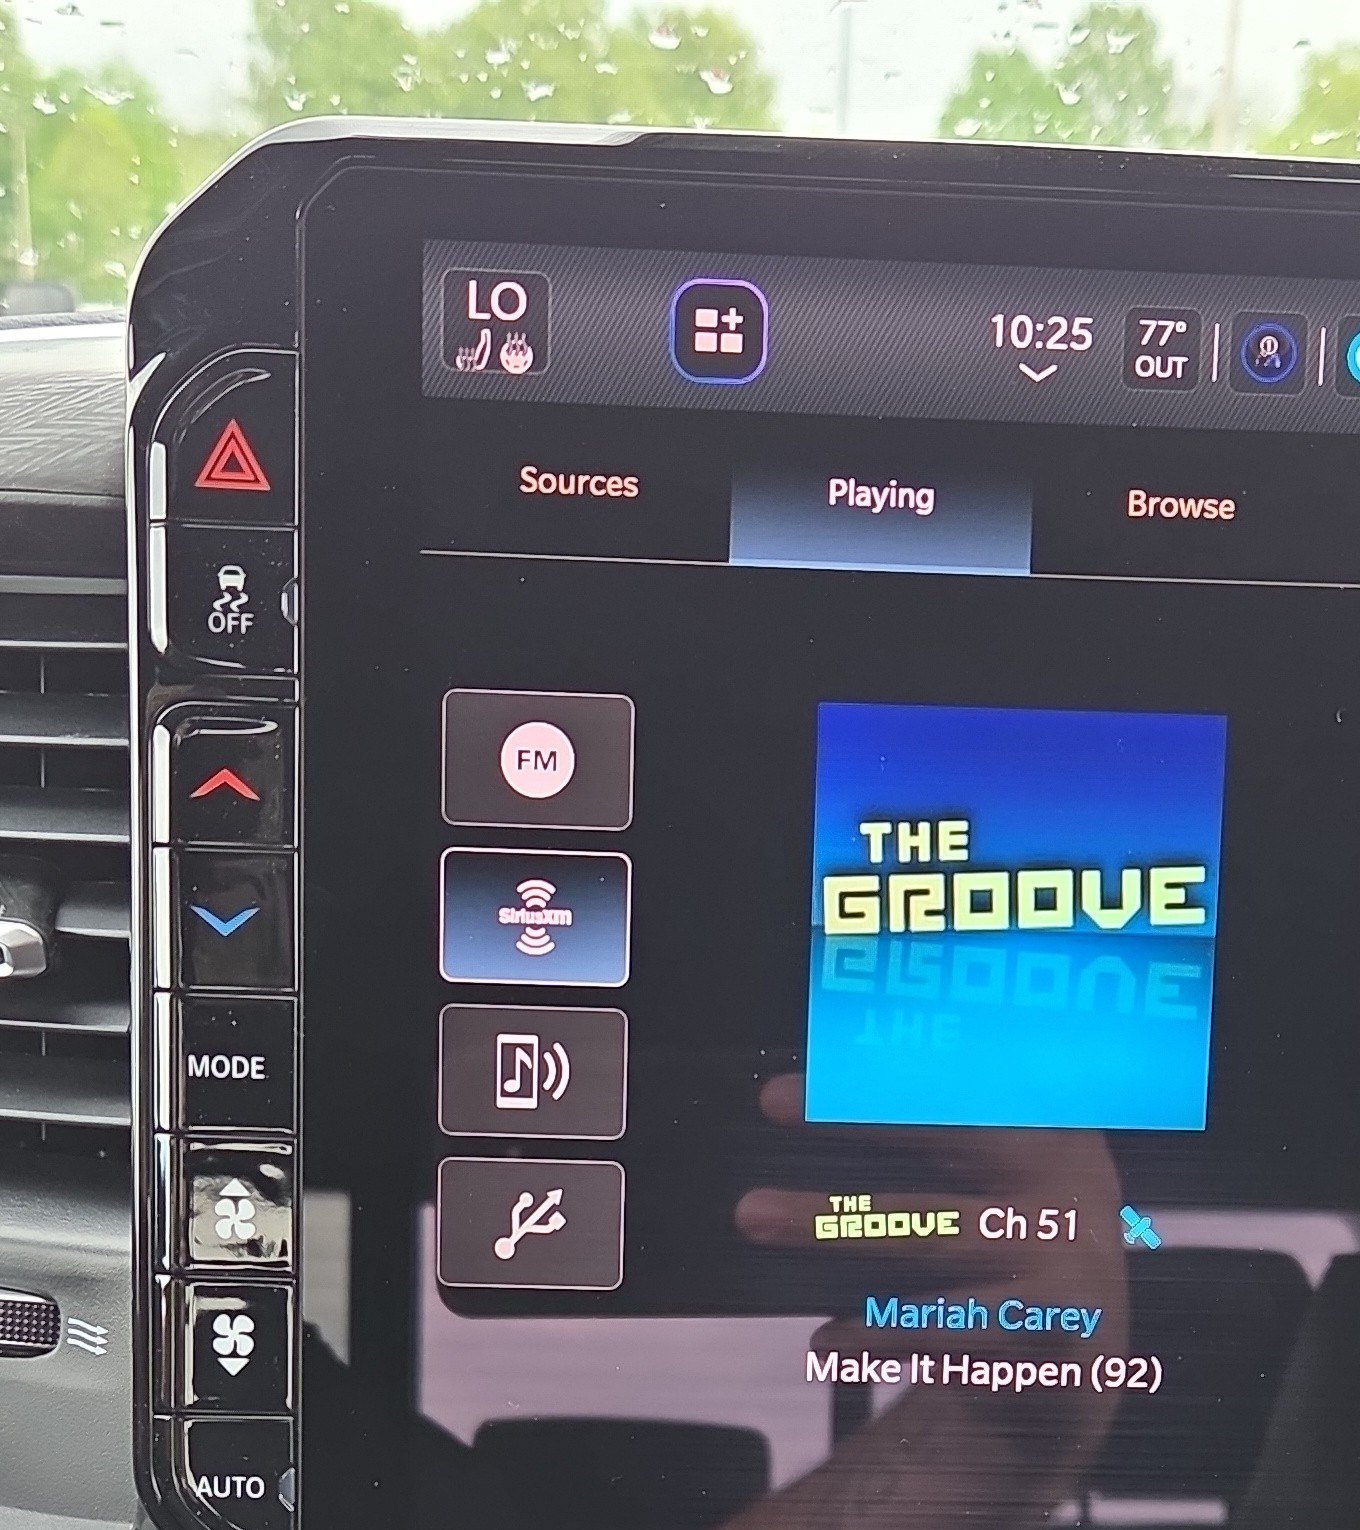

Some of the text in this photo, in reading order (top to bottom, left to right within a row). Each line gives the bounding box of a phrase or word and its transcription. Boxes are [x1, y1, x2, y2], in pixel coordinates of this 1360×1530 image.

[467, 280, 527, 321] LO
[990, 315, 1093, 351] 10:25
[1138, 320, 1187, 348] 77°
[1134, 353, 1187, 379] OUT
[520, 466, 639, 498] Sources
[828, 478, 935, 515] Playing
[1127, 489, 1235, 520] Browse
[207, 612, 253, 634] OFF
[517, 750, 557, 771] FM
[859, 820, 970, 863] THE
[823, 864, 1206, 935] GROOVE
[187, 1054, 266, 1080] MODE
[829, 1194, 872, 1213] THE
[814, 1211, 960, 1240] GROOVE
[979, 1207, 1077, 1241] Ch 51
[865, 1296, 1103, 1339] Mariah Carey
[806, 1351, 1163, 1393] Make It Happen (92)
[195, 1475, 266, 1498] AUTO
